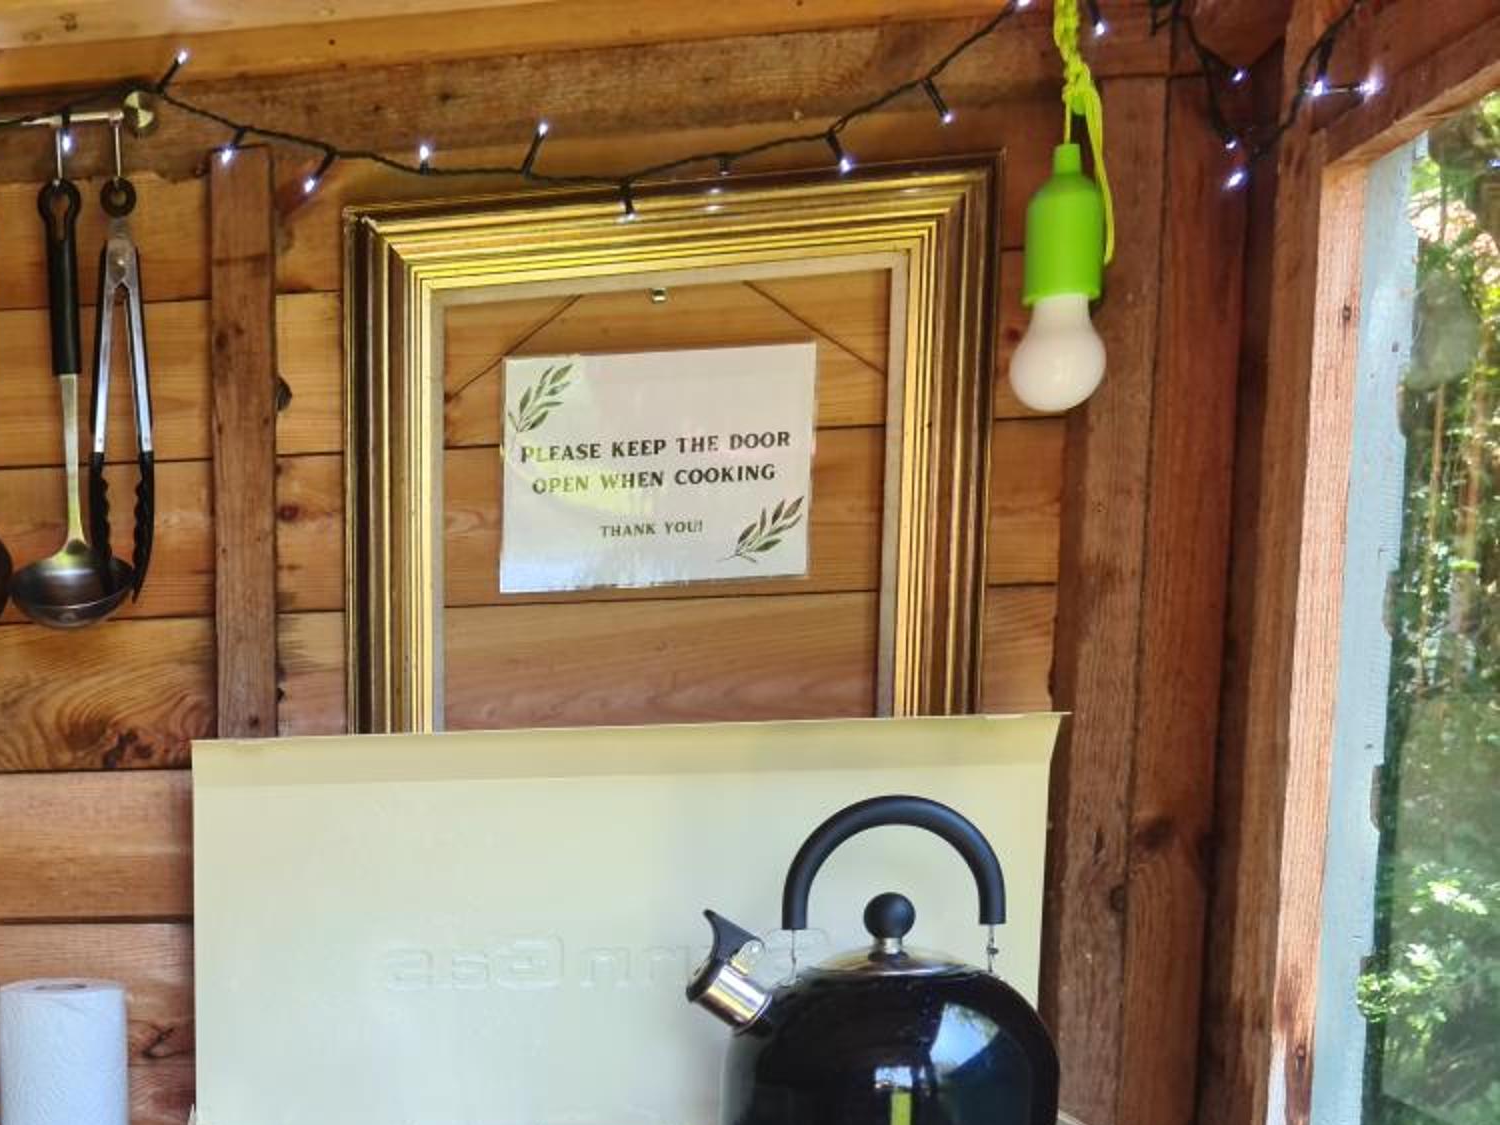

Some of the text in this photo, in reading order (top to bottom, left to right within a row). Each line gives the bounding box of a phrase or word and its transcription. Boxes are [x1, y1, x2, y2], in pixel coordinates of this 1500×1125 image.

[520, 430, 791, 464] PLEASE KEEP THE DOOR
[532, 463, 777, 495] OPEN WHEN COOKING
[600, 522, 657, 539] THANK
